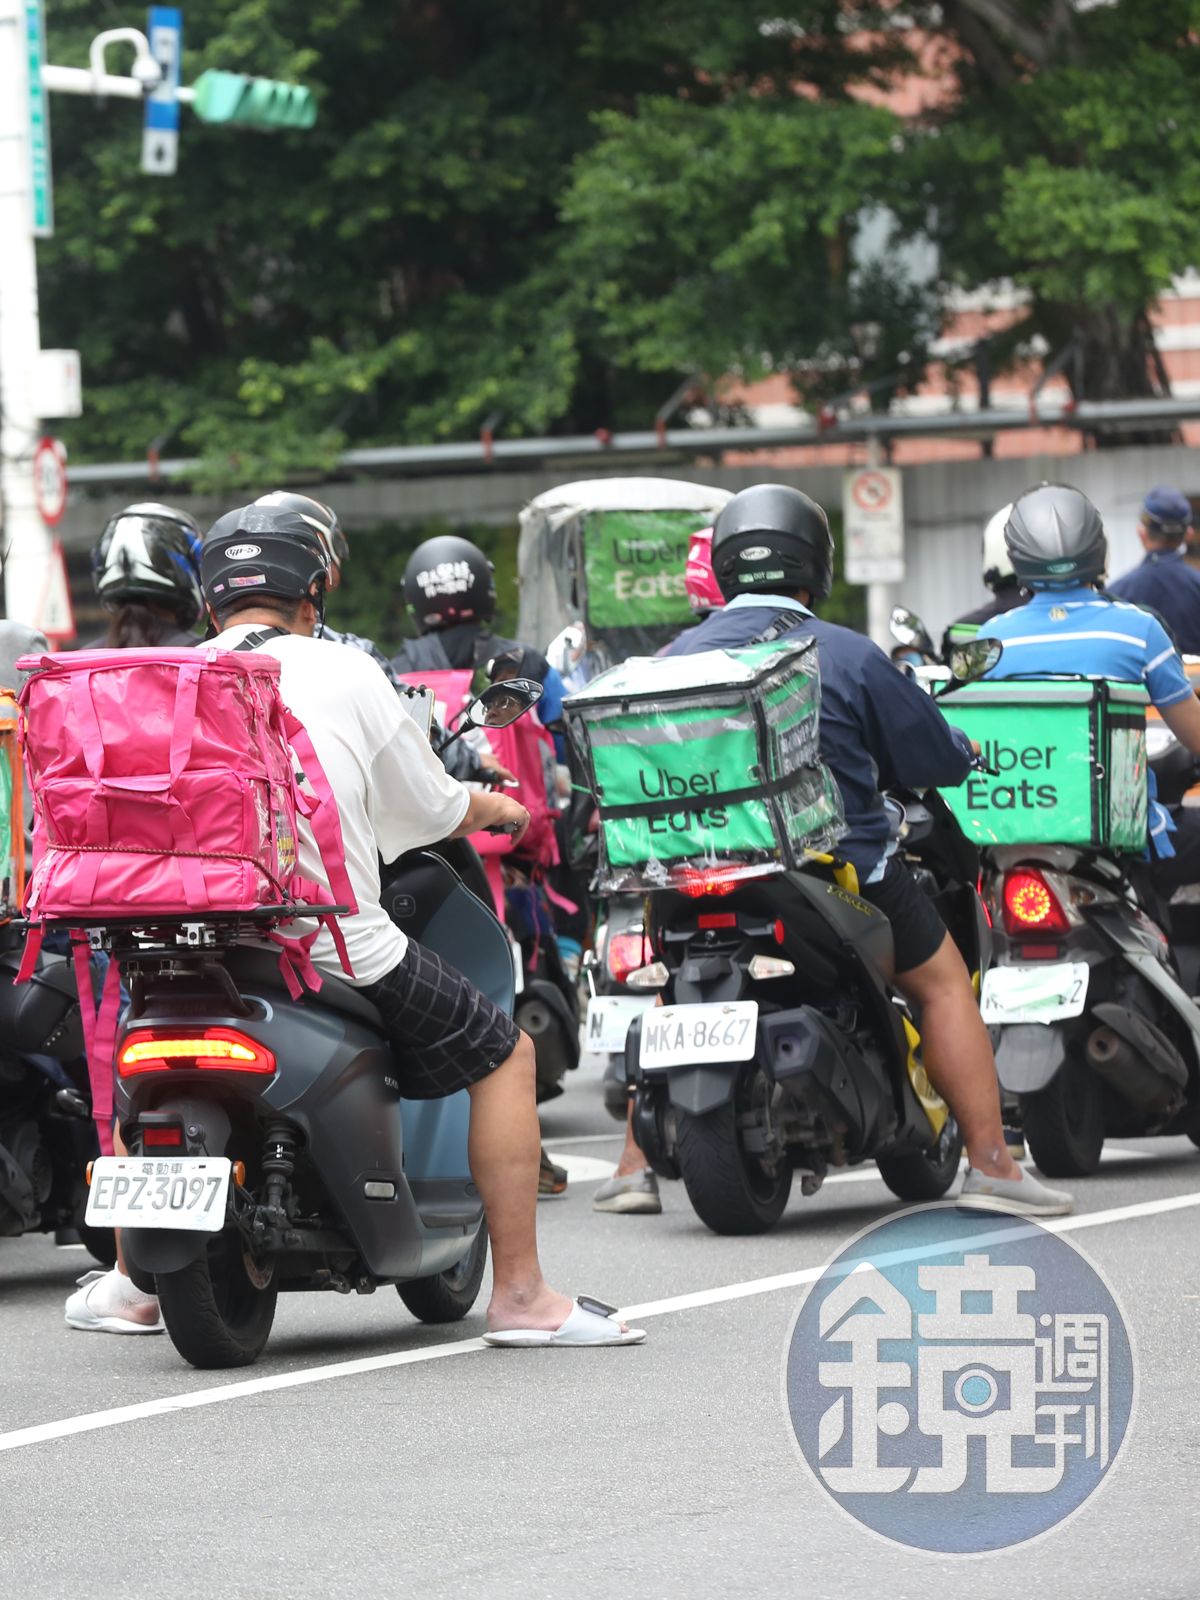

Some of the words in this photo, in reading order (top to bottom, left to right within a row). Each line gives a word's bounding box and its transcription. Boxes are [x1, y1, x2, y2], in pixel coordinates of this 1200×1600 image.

[613, 538, 685, 566] Uber
[615, 569, 687, 600] Eats
[639, 768, 720, 799] Uber
[966, 778, 1058, 810] Eats
[141, 1162, 183, 1175] 電動車
